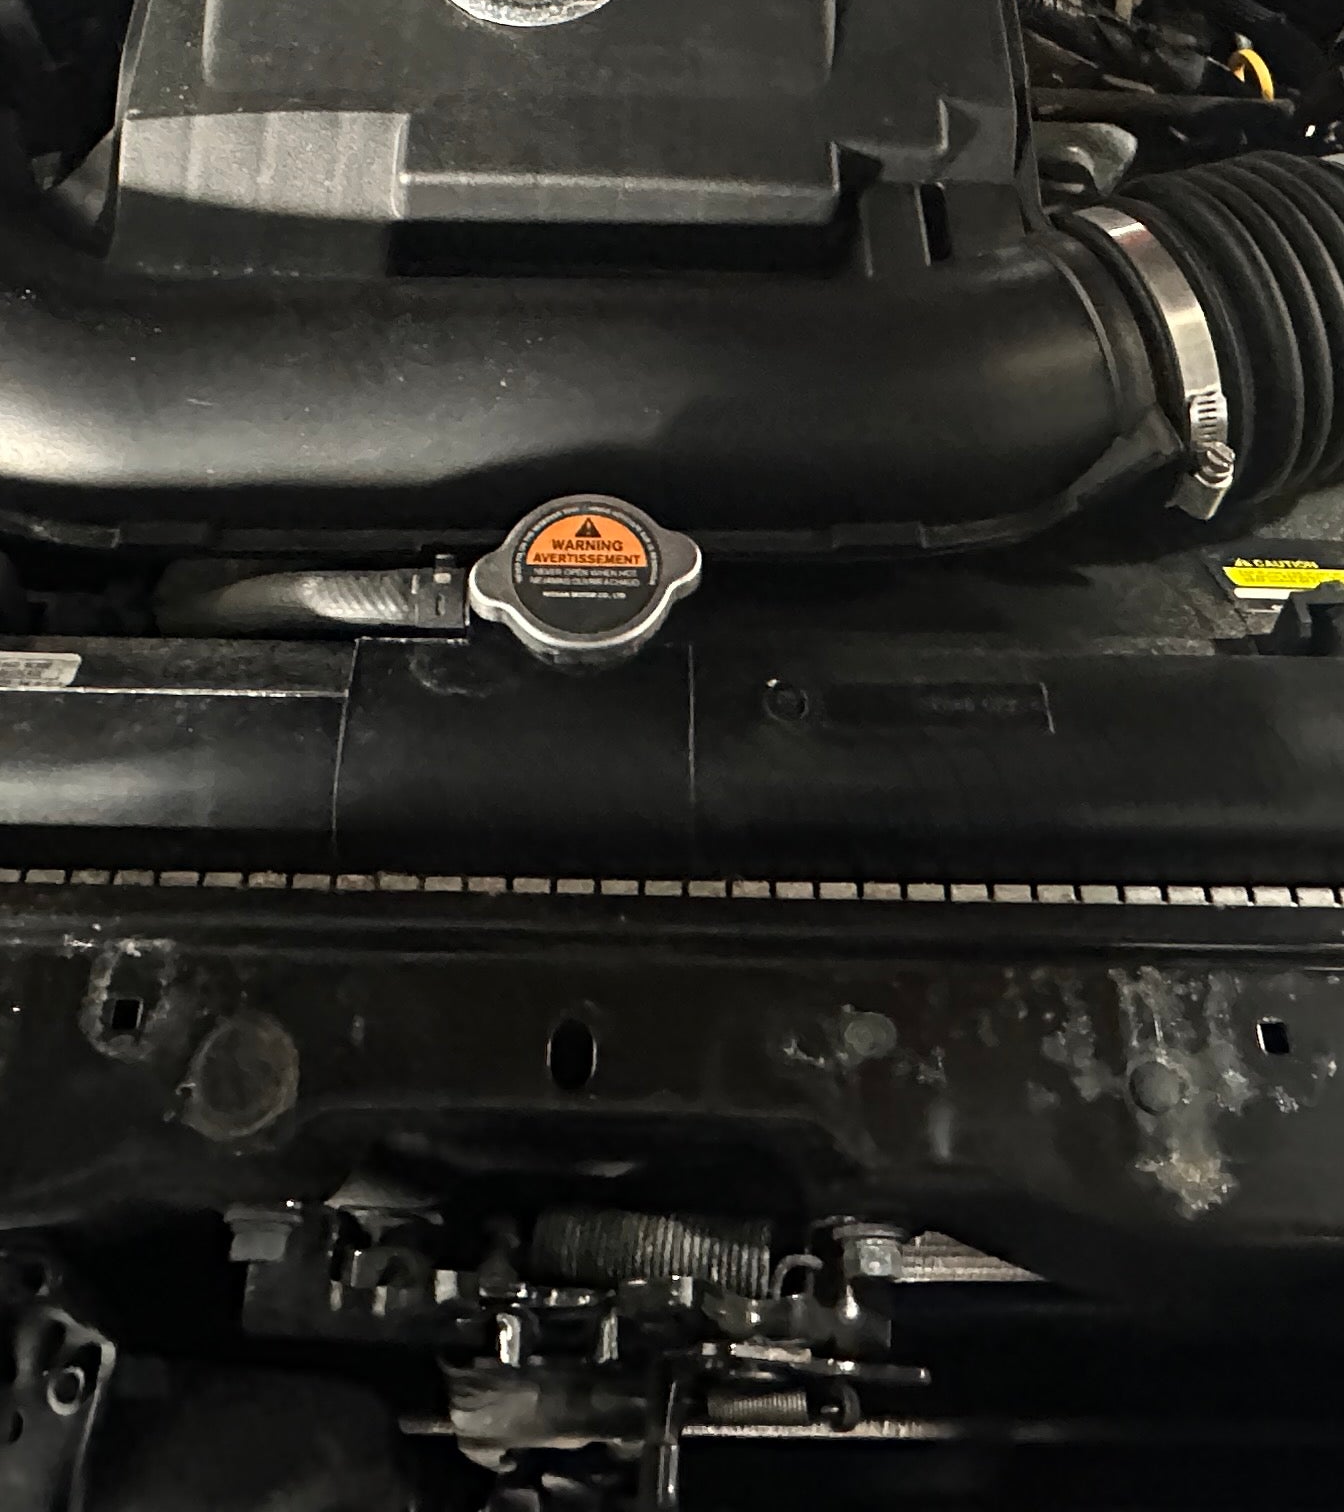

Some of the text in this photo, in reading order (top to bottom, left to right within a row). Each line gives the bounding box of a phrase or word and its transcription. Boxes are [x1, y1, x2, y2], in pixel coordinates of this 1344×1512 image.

[551, 538, 624, 552] WARNING
[532, 552, 641, 565] AVERTISSEMENT
[1253, 559, 1320, 569] CAUTION
